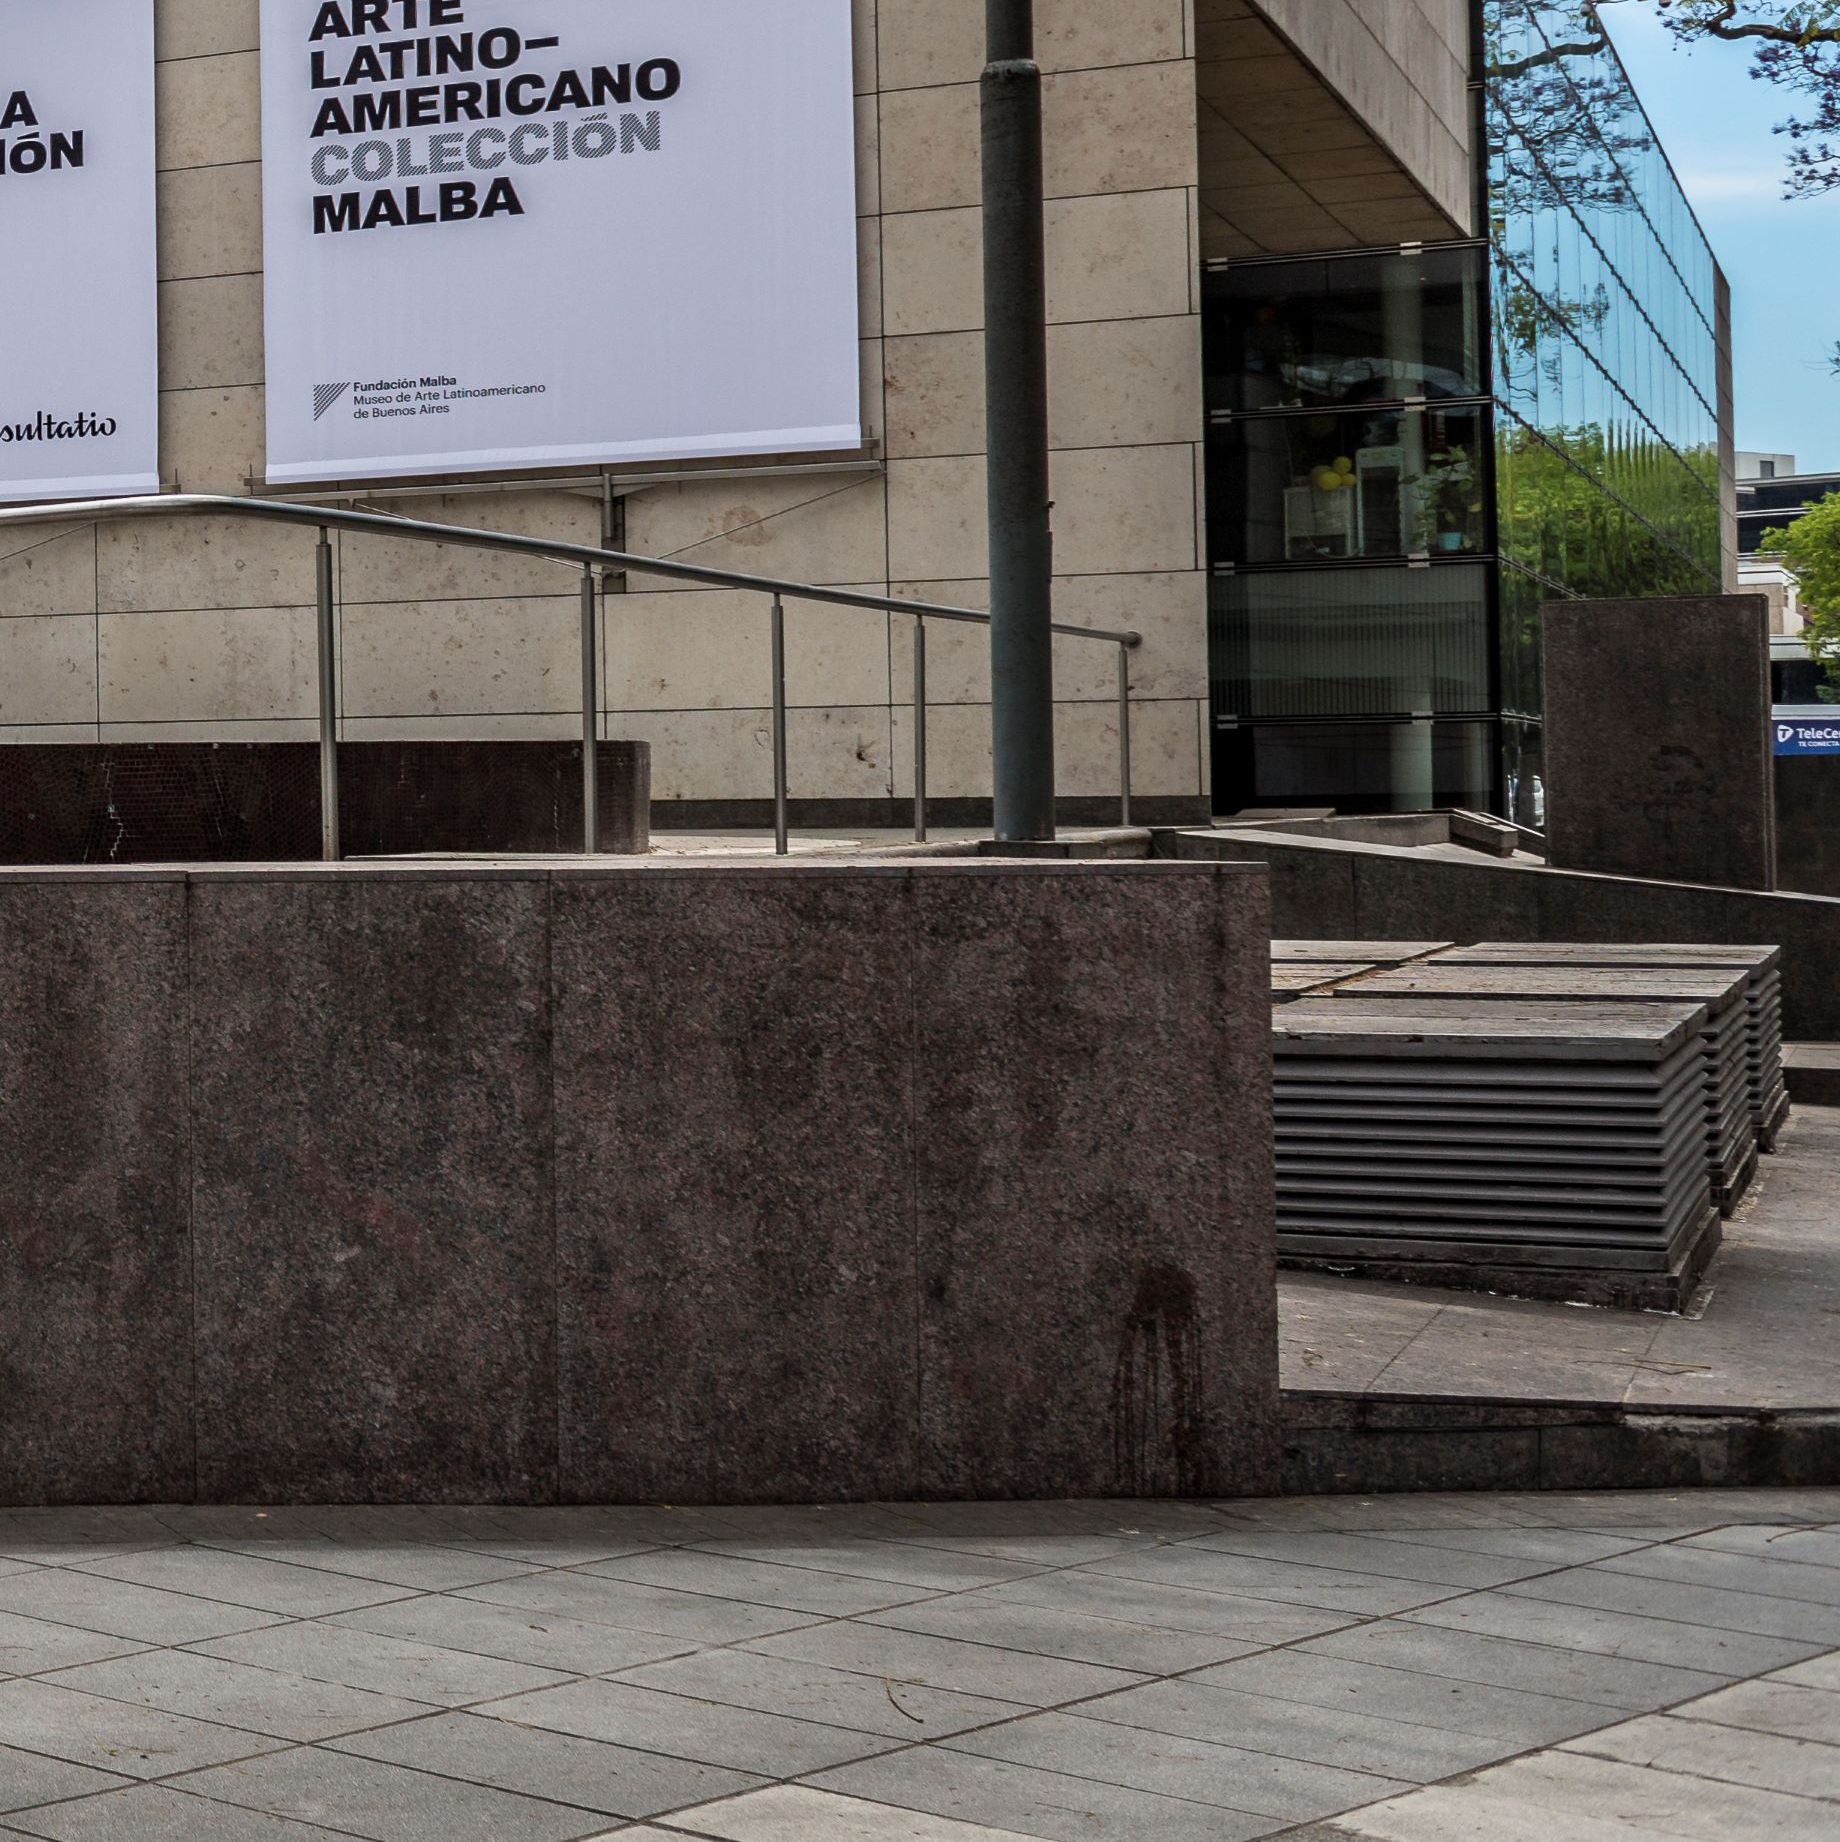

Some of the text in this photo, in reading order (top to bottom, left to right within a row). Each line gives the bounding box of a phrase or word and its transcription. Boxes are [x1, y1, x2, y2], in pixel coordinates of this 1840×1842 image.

[310, 58, 681, 138] AMERICANO
[310, 110, 661, 186] COLECCIÓN
[313, 176, 524, 234] MALBA
[353, 376, 457, 392] Fundación Malba
[354, 383, 546, 405] Museo de Arte Latinoamericano
[354, 403, 450, 419] de Buenos Aires
[1796, 728, 1840, 739] TeleCe
